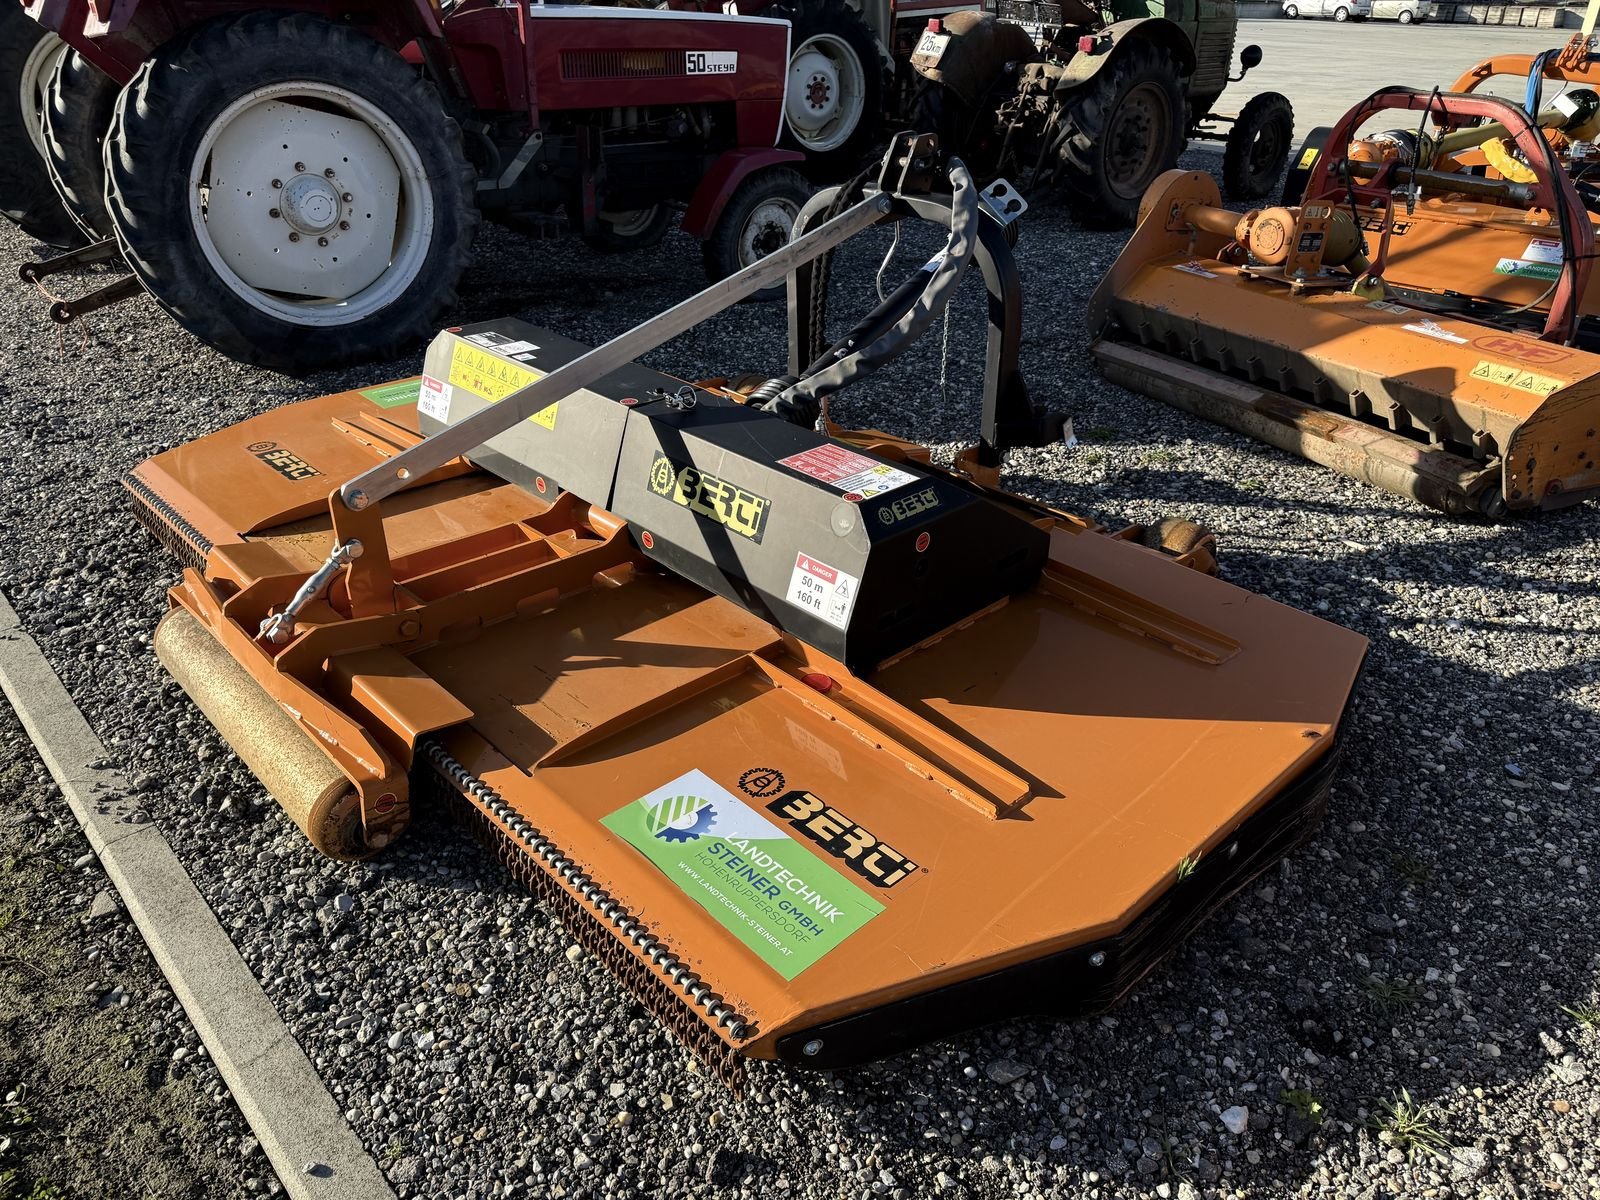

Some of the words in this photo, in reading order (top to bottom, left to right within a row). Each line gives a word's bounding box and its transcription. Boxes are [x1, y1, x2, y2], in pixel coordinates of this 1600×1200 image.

[687, 53, 706, 73] 50
[706, 63, 735, 73] STEYR
[1359, 215, 1410, 236] BETI
[811, 564, 833, 579] DANGER
[801, 575, 813, 588] 50
[814, 583, 823, 594] m
[797, 590, 812, 605] 160
[814, 598, 821, 610] ft
[723, 832, 845, 925] LANDTECHNIK
[694, 852, 812, 944] HOHENRUPPERSDORF
[708, 842, 781, 901] STEINER
[778, 901, 824, 937] GMBH
[677, 860, 793, 957] WWW.LANDTECHNIK-STEINER.AT
